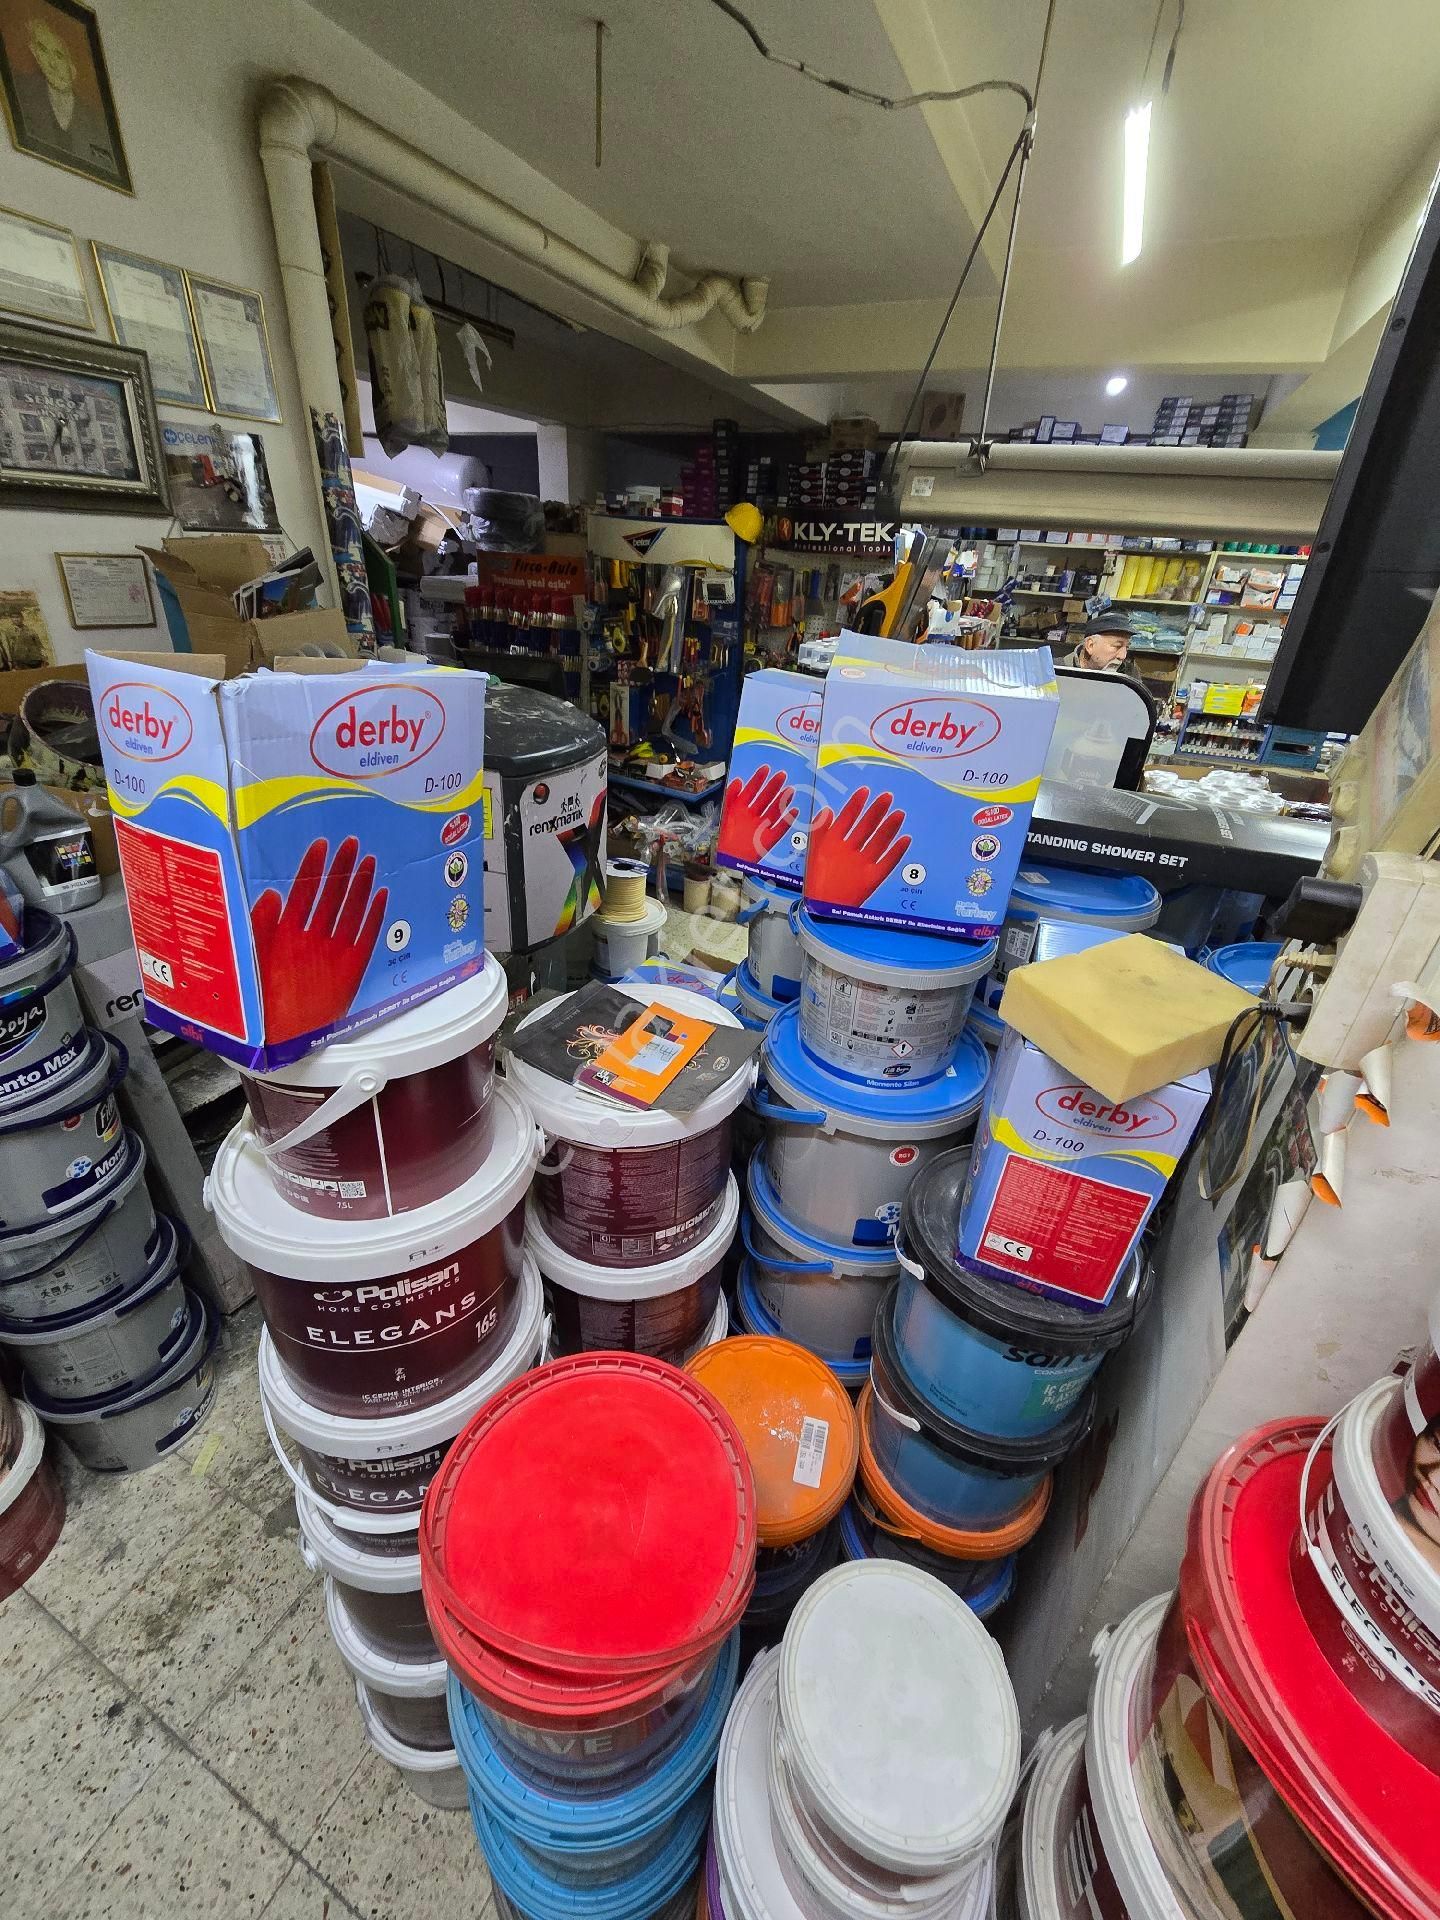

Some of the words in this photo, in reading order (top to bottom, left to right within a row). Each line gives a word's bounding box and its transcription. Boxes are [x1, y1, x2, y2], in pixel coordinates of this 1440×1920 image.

[794, 522, 895, 542] KLY-TEK
[109, 694, 173, 749] derby
[336, 704, 425, 752] derby
[891, 709, 977, 749] derby
[125, 737, 153, 755] eldiven
[906, 741, 943, 754] eldiven
[360, 752, 399, 768] eldiven
[114, 768, 146, 794] D-100
[424, 772, 462, 794] D-100
[963, 769, 1009, 785] D-100
[1092, 842, 1156, 864] SHOWER
[1158, 853, 1188, 868] SET
[909, 868, 919, 880] 8
[885, 916, 906, 926] DERBY
[394, 929, 404, 944] 9
[378, 1001, 401, 1018] DERBY
[43, 1047, 77, 1075] Max
[1058, 1091, 1151, 1133] derby
[1073, 1117, 1112, 1133] eldiven
[1033, 1129, 1084, 1152] D-100
[356, 1262, 460, 1304] Polisan
[318, 1305, 361, 1313] HOME
[371, 1277, 460, 1311] COSMETICS
[306, 1291, 476, 1345] ELEGANS
[475, 1307, 498, 1337] 165
[349, 1450, 440, 1473] Polisan
